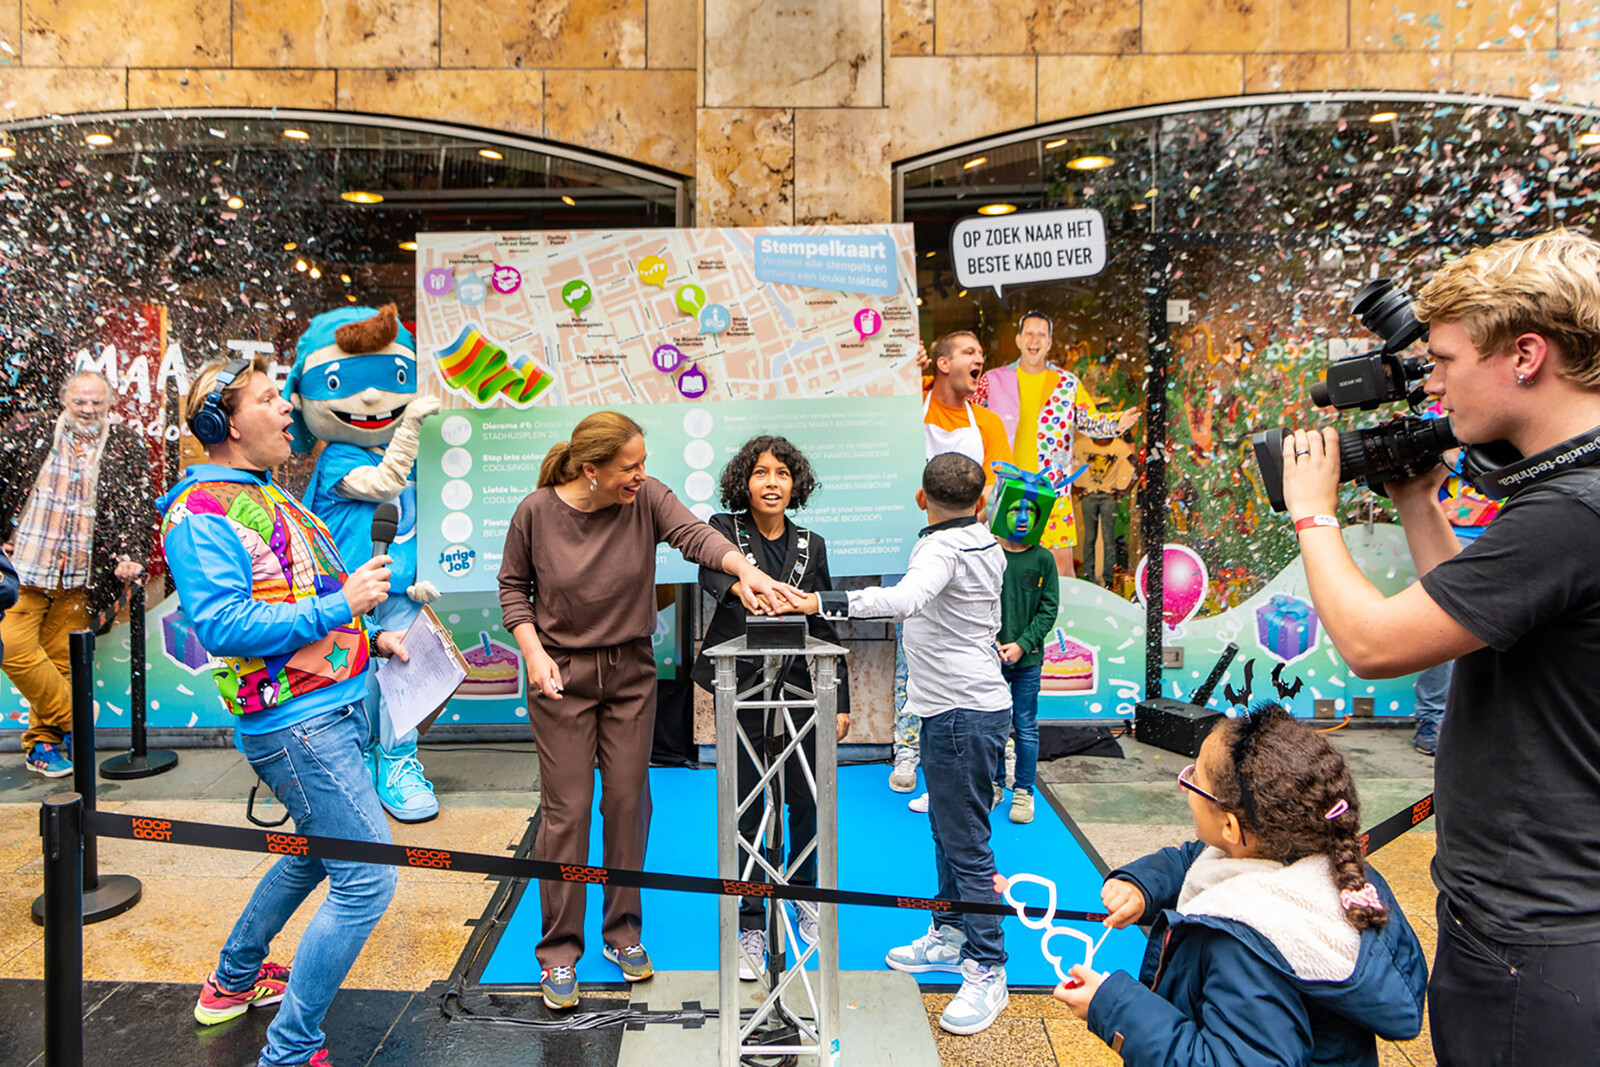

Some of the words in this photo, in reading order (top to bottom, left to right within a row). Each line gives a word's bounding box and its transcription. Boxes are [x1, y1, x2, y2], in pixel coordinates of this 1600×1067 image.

[963, 231, 981, 248] OP
[986, 226, 1021, 246] ZOEK
[1026, 223, 1062, 242] NAAR
[1067, 220, 1092, 238] HET
[761, 239, 886, 259] Stempelkaart
[805, 258, 823, 268] alle
[826, 261, 872, 273] stempels
[874, 264, 887, 273] en
[968, 255, 1010, 274] BESTE
[1015, 251, 1052, 270] KADO
[1057, 247, 1092, 266] EVER
[798, 272, 817, 281] een
[819, 272, 846, 284] leuke
[848, 275, 888, 288] traktatie
[482, 421, 517, 430] Diorama
[482, 432, 546, 441] STADHUISPLEIN
[483, 454, 502, 463] Step
[504, 453, 520, 461] into
[483, 463, 536, 472] COOLSINGEL
[483, 485, 508, 494] Liefde
[438, 549, 476, 565] Jarige
[833, 546, 901, 556] HANDELSGEBOUW
[447, 560, 471, 573] Job
[1413, 796, 1432, 815] KOOP
[1412, 806, 1431, 825] GOOT
[132, 818, 172, 831] KOOP
[133, 828, 173, 841] GOOT
[266, 833, 308, 846] KOOP
[267, 843, 309, 855] GOOT
[405, 848, 451, 860] KOOP
[408, 857, 452, 869] GOOT
[560, 865, 608, 876] KOOP
[562, 873, 609, 884] GOOT
[722, 880, 774, 890] KOOP
[897, 896, 951, 905] KOOP
